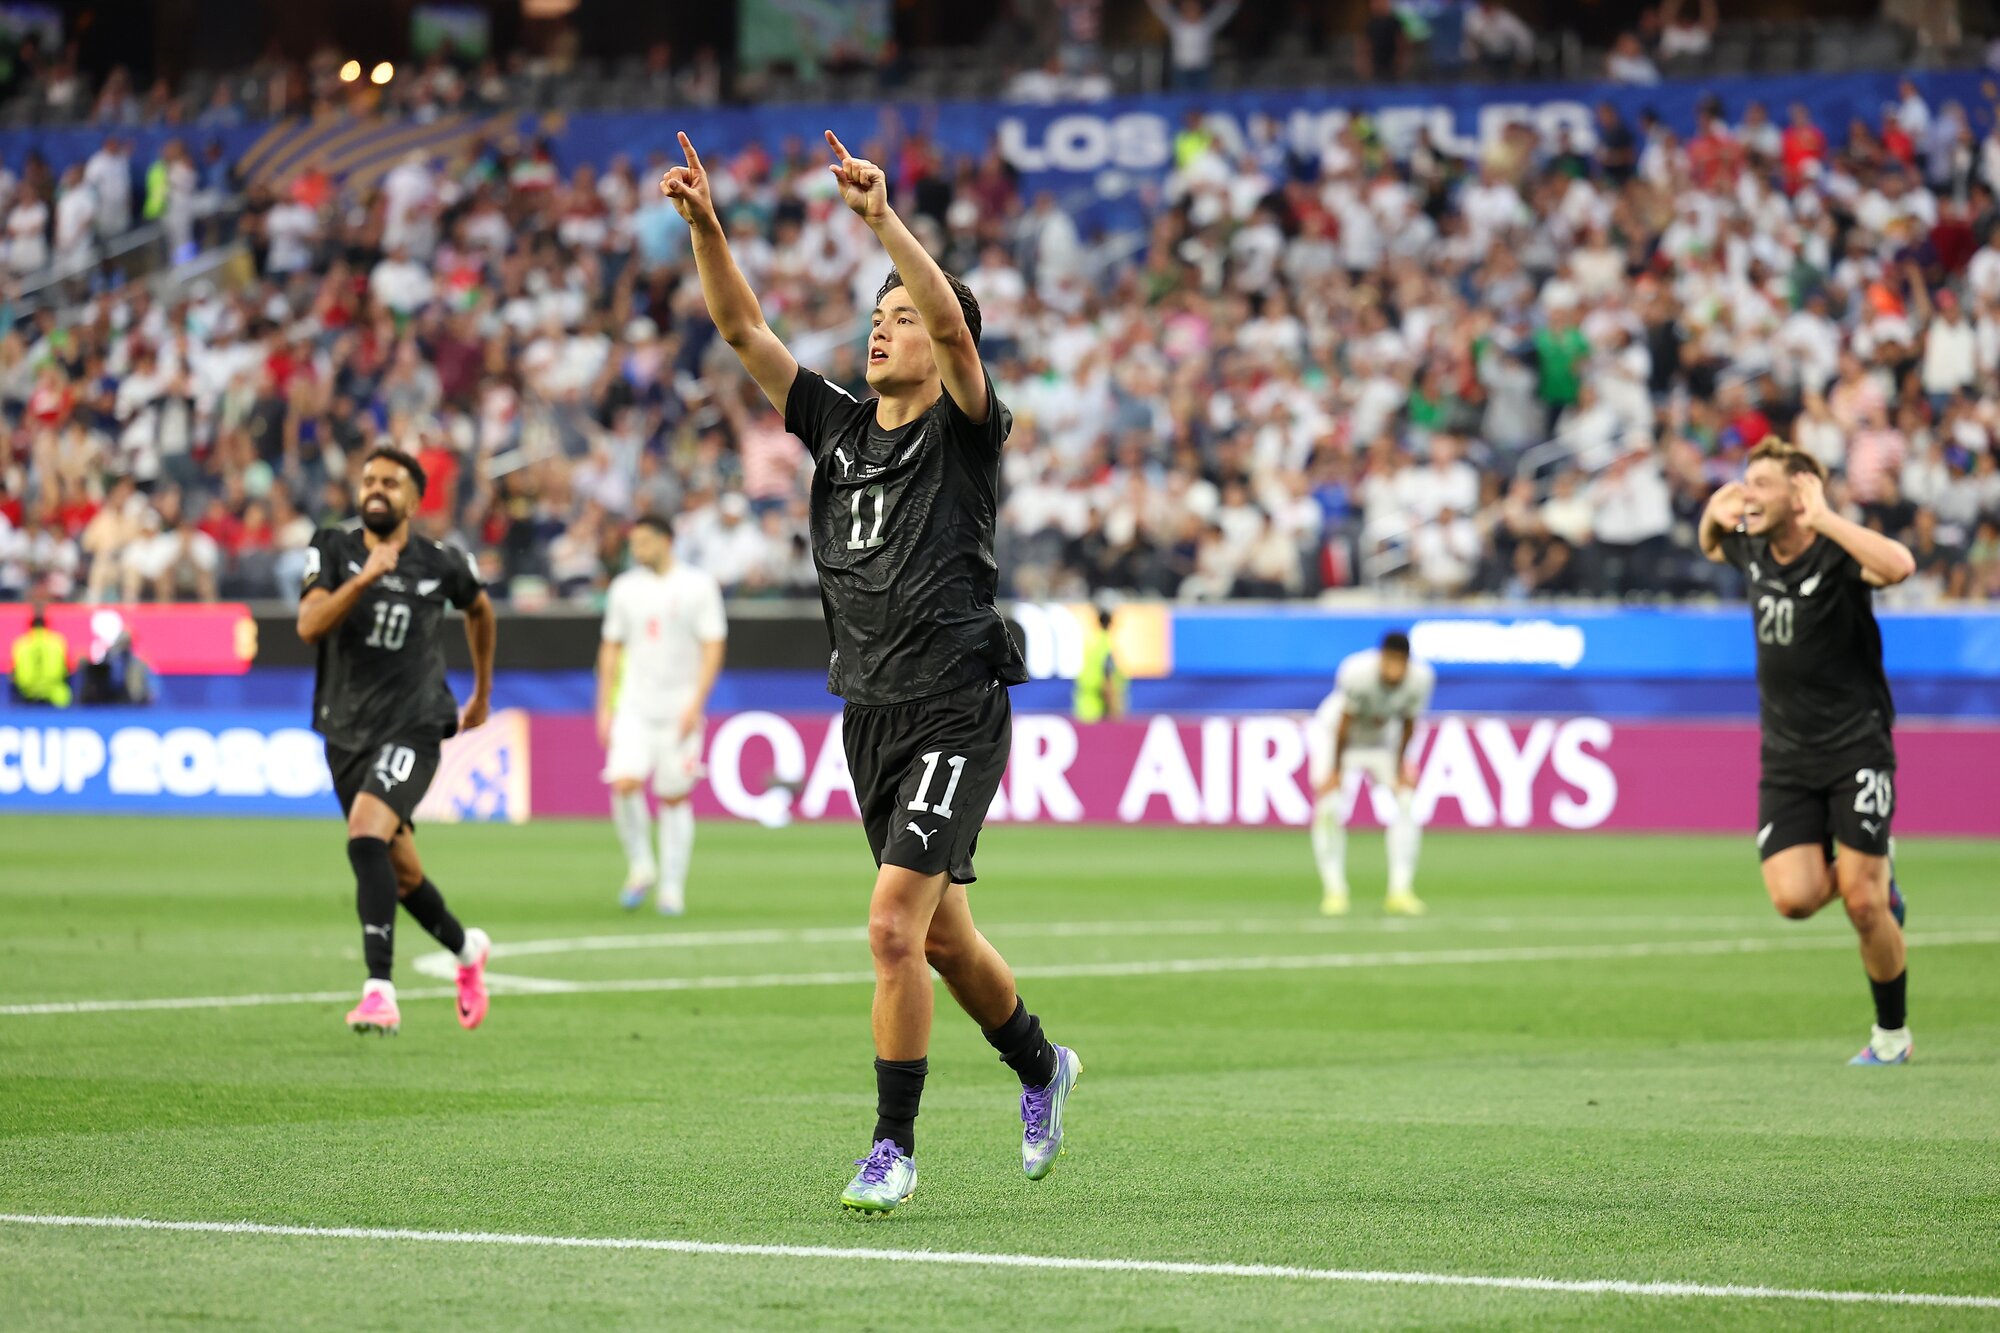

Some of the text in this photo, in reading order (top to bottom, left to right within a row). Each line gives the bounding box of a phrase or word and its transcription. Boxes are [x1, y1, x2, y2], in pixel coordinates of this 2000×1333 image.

[1001, 112, 1169, 171] LOS
[847, 484, 885, 549] 11
[365, 600, 411, 650] 10
[1758, 595, 1794, 646] 20
[108, 727, 330, 797] 2026
[374, 743, 416, 782] 10
[709, 711, 1085, 828] QAR
[907, 752, 968, 819] 11
[1853, 768, 1892, 817] 20
